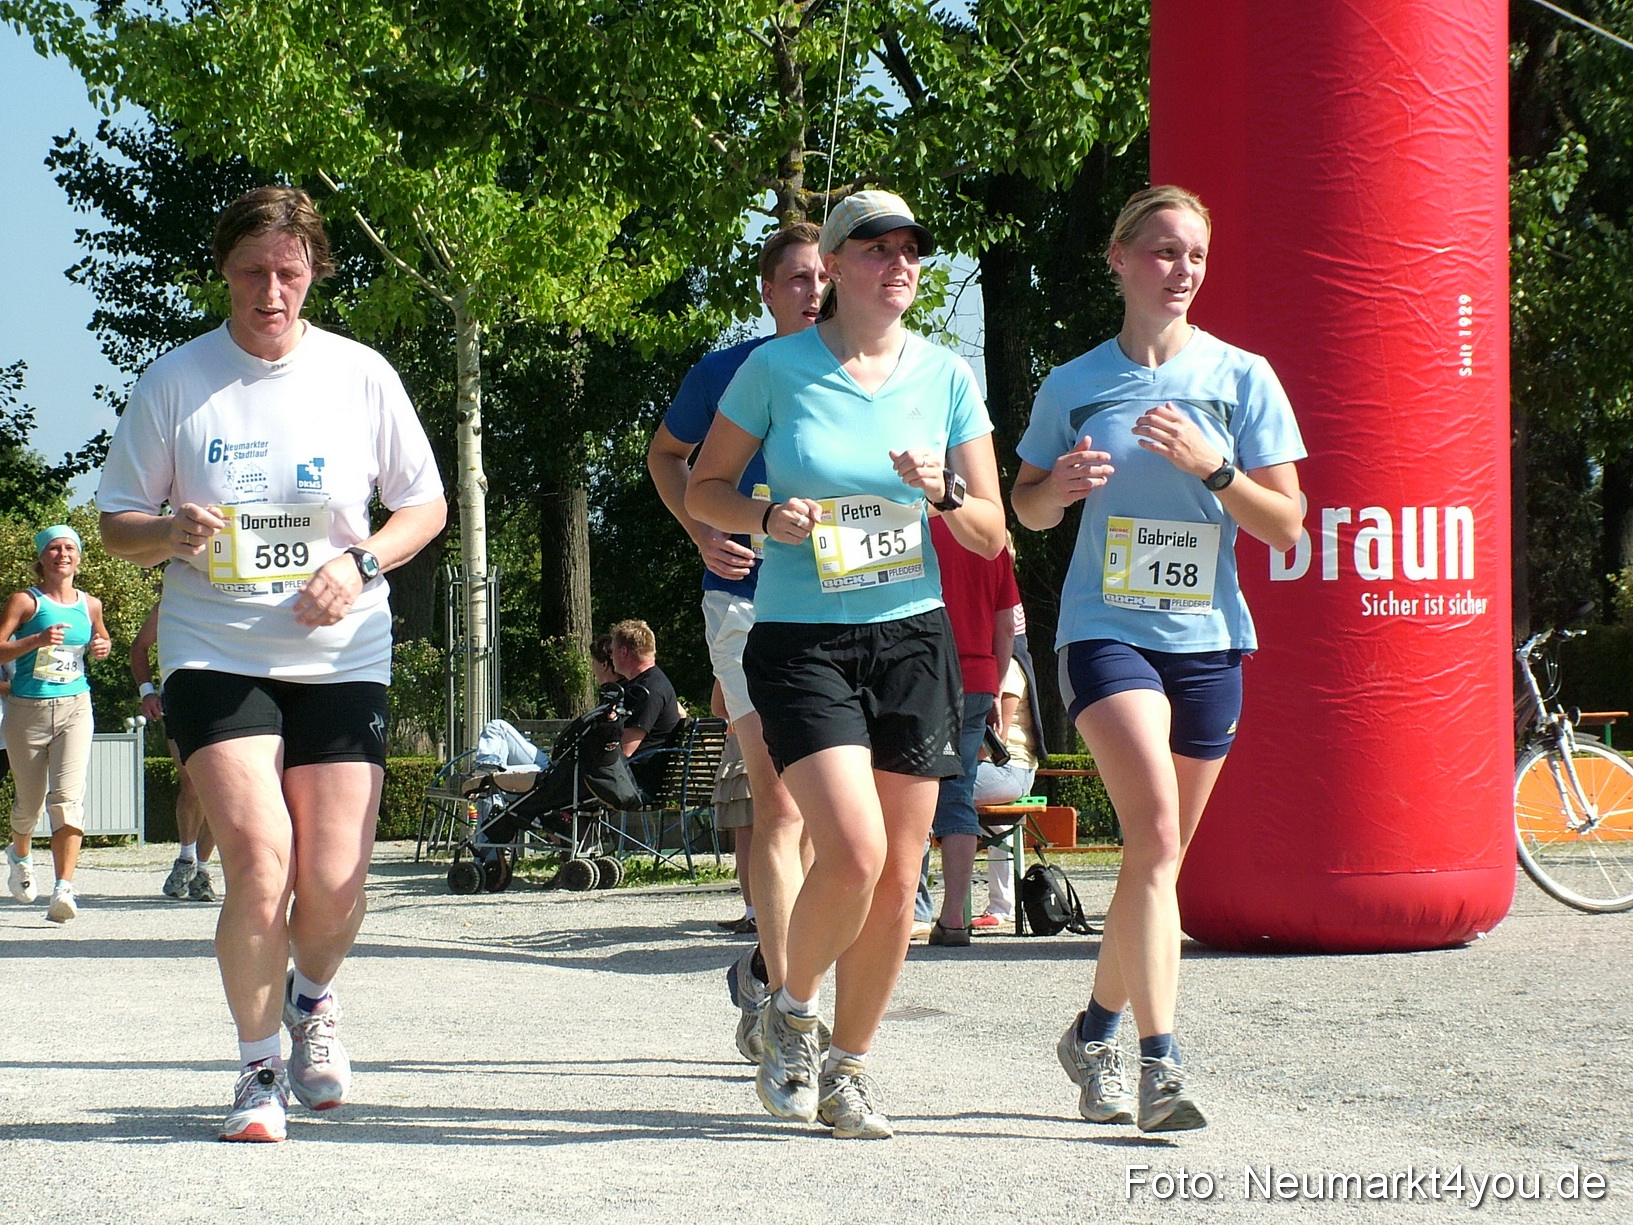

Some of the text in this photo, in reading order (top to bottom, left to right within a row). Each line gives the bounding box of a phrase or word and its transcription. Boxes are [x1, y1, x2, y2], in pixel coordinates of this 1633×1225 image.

[1458, 294, 1473, 376] Seit 1929
[224, 440, 269, 453] Neumarkter
[233, 449, 269, 460] Stadtlauf
[298, 480, 322, 489] DKMS
[841, 504, 881, 522] Petra
[241, 513, 311, 530] Dorothea
[819, 536, 827, 549] D
[860, 528, 907, 559] 155
[1137, 527, 1197, 548] Gabriele
[214, 541, 221, 553] D
[255, 542, 309, 569] 589
[1109, 552, 1117, 564] D
[889, 564, 923, 577] PFLEIDERER
[1148, 560, 1198, 587] 158
[1171, 598, 1211, 608] PFLEIDERER
[1361, 589, 1488, 616] Sicher ist sicher
[55, 660, 78, 672] 248
